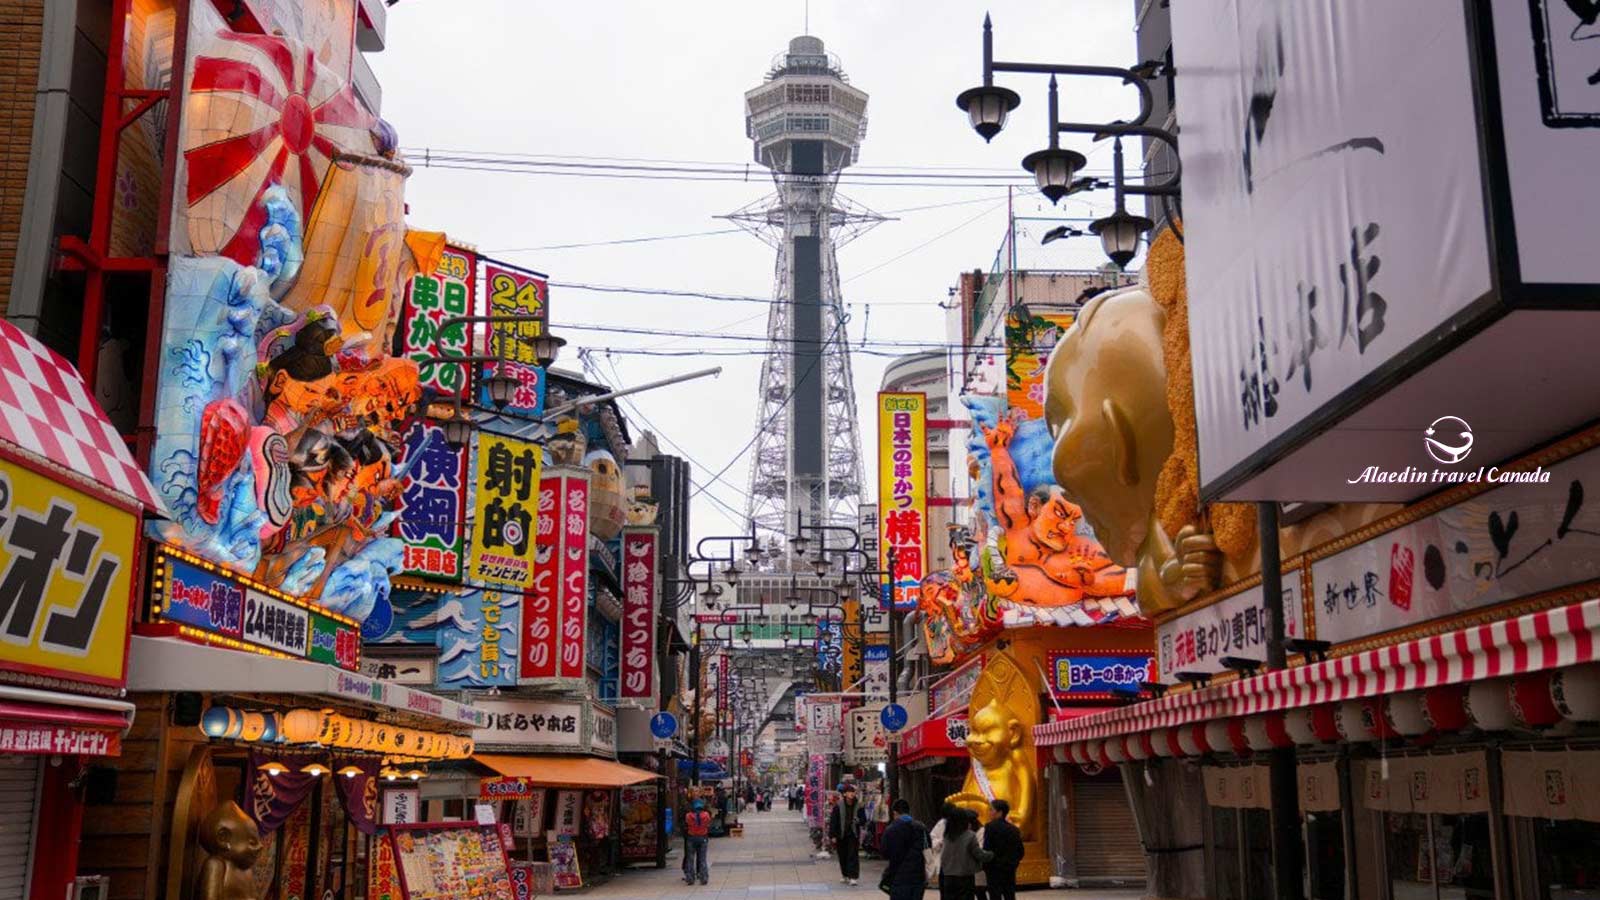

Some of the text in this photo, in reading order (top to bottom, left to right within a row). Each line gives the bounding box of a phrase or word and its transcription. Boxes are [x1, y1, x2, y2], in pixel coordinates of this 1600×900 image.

[410, 276, 440, 383] 串かつ
[491, 274, 544, 315] 24
[402, 421, 461, 546] 横綱
[893, 412, 913, 509] 日本一の串かつ
[482, 442, 537, 557] 射的
[477, 564, 529, 583] チャンピオン
[885, 510, 922, 582] 横綱
[246, 598, 306, 650] 24時間営業
[529, 570, 554, 668] てっちり
[564, 570, 583, 668] てっちり
[1323, 571, 1385, 617] 新世界
[1071, 665, 1146, 684] 日本一の串かつ
[55, 728, 108, 754] チャンピオン
